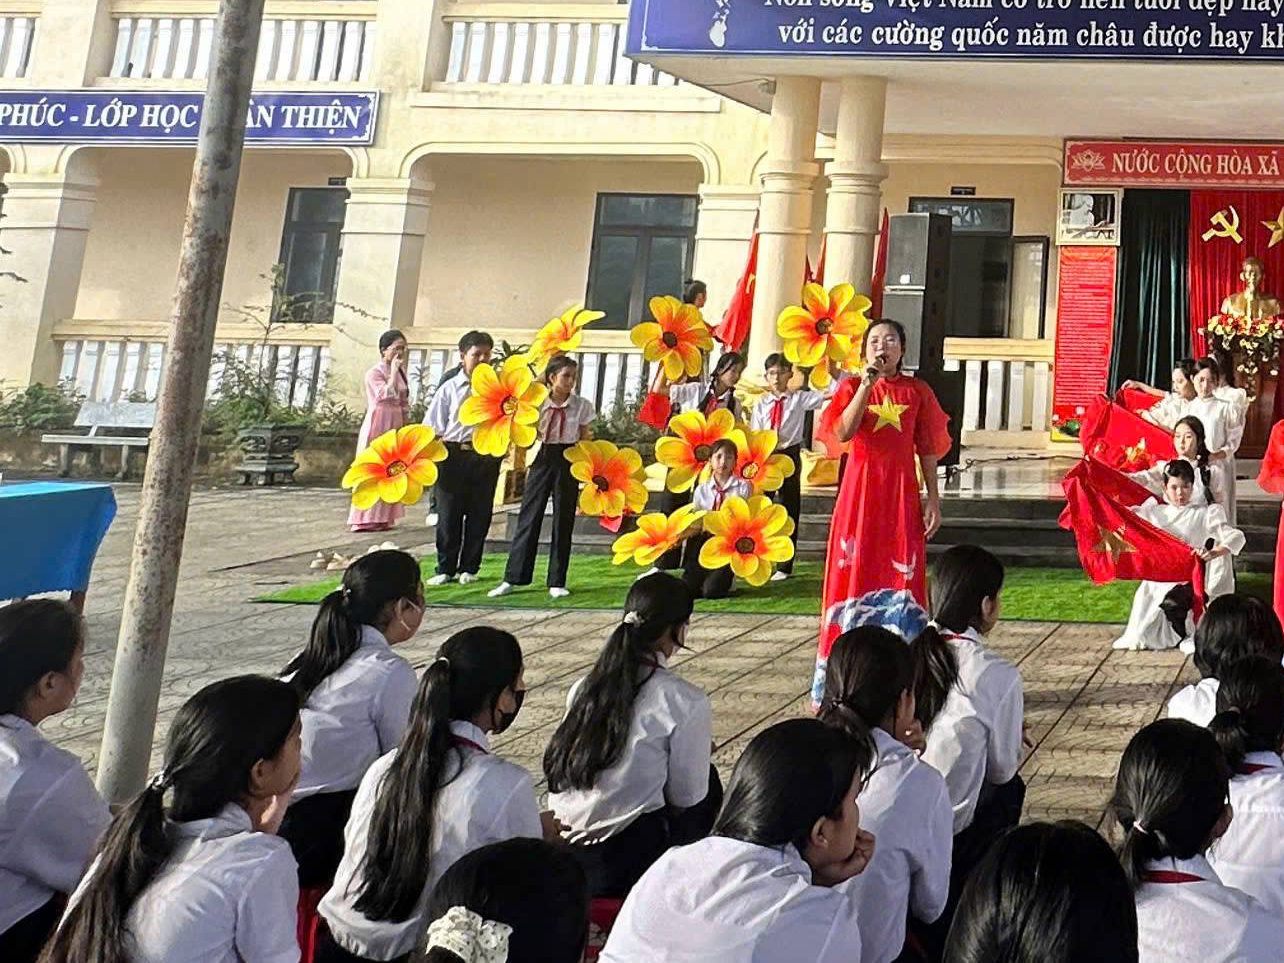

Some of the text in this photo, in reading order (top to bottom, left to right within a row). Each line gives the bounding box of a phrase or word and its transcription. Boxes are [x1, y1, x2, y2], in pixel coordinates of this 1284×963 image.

[778, 18, 814, 43] với
[822, 18, 862, 44] các
[872, 20, 944, 50] cường
[952, 18, 1008, 51] quốc
[1016, 23, 1068, 45] năm
[1077, 21, 1134, 46] châu
[1143, 22, 1201, 53] được
[1209, 23, 1253, 54] hay
[0, 97, 66, 127] PHÚC
[84, 98, 138, 127] LỚP
[141, 103, 197, 134] HỌC
[281, 99, 362, 135] THIỆN
[1111, 150, 1159, 174] NƯỚC
[1165, 149, 1212, 177] CỘNG
[1217, 150, 1252, 175] HÒA
[1257, 151, 1279, 175] XÃ
